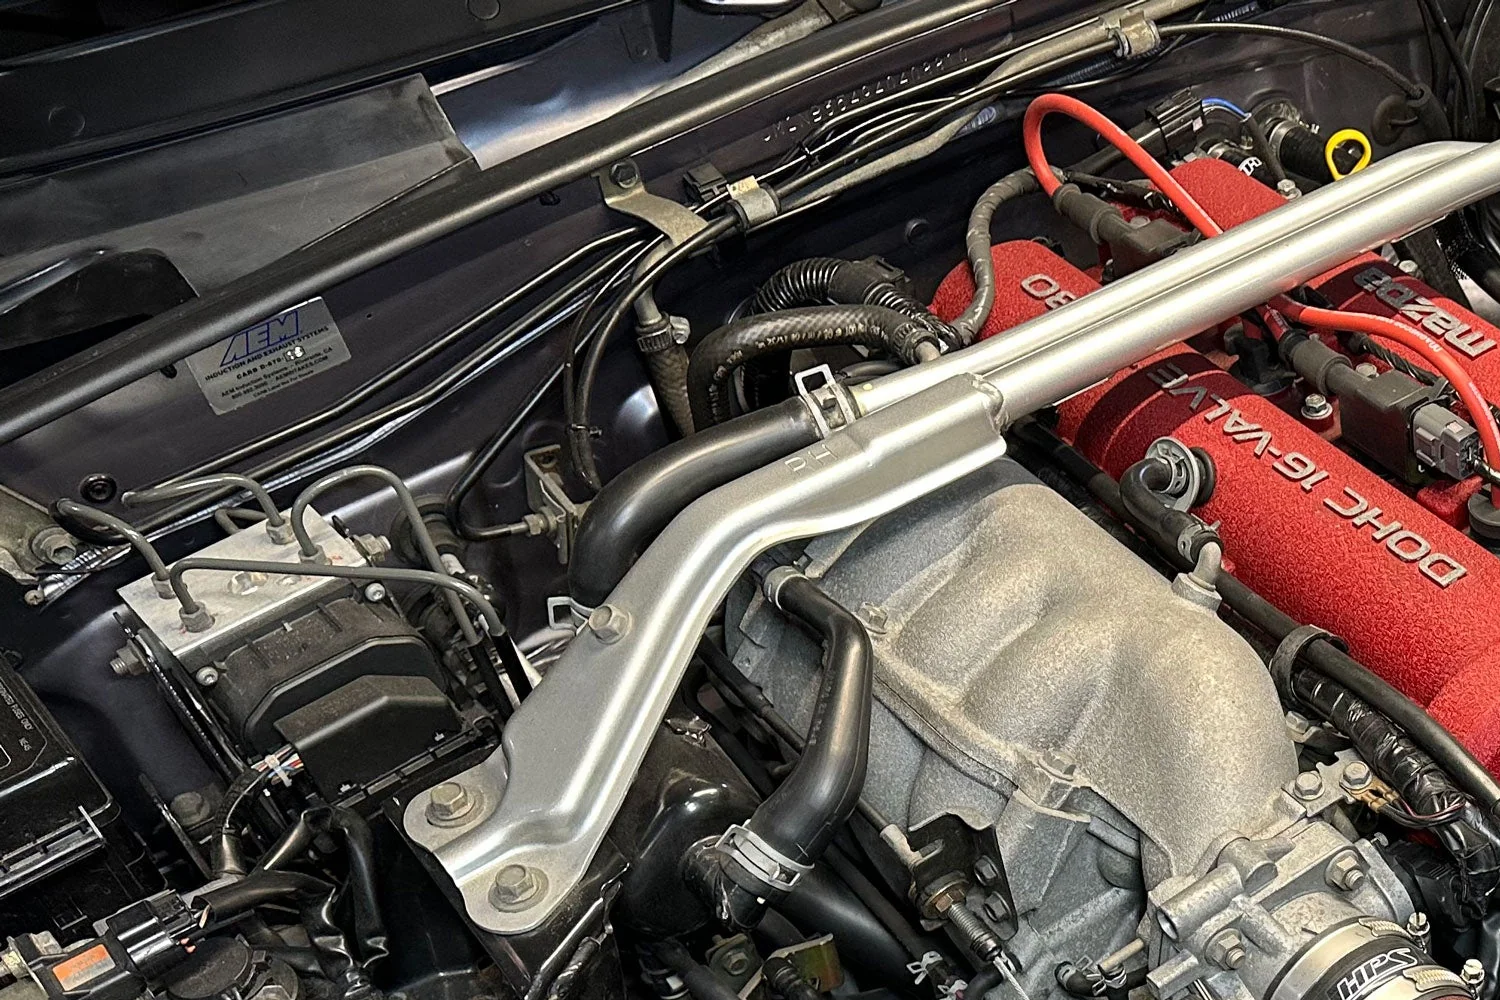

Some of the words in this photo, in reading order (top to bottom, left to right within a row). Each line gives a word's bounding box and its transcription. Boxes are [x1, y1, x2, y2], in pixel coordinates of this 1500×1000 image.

[204, 361, 247, 382] INDUCTION
[246, 354, 263, 366] AND
[263, 340, 297, 357] EXHAUST
[296, 325, 330, 343] SYSTEMS
[220, 308, 301, 368] AEM
[1147, 361, 1330, 492] 16-VALVE
[1322, 486, 1469, 588] DOHC
